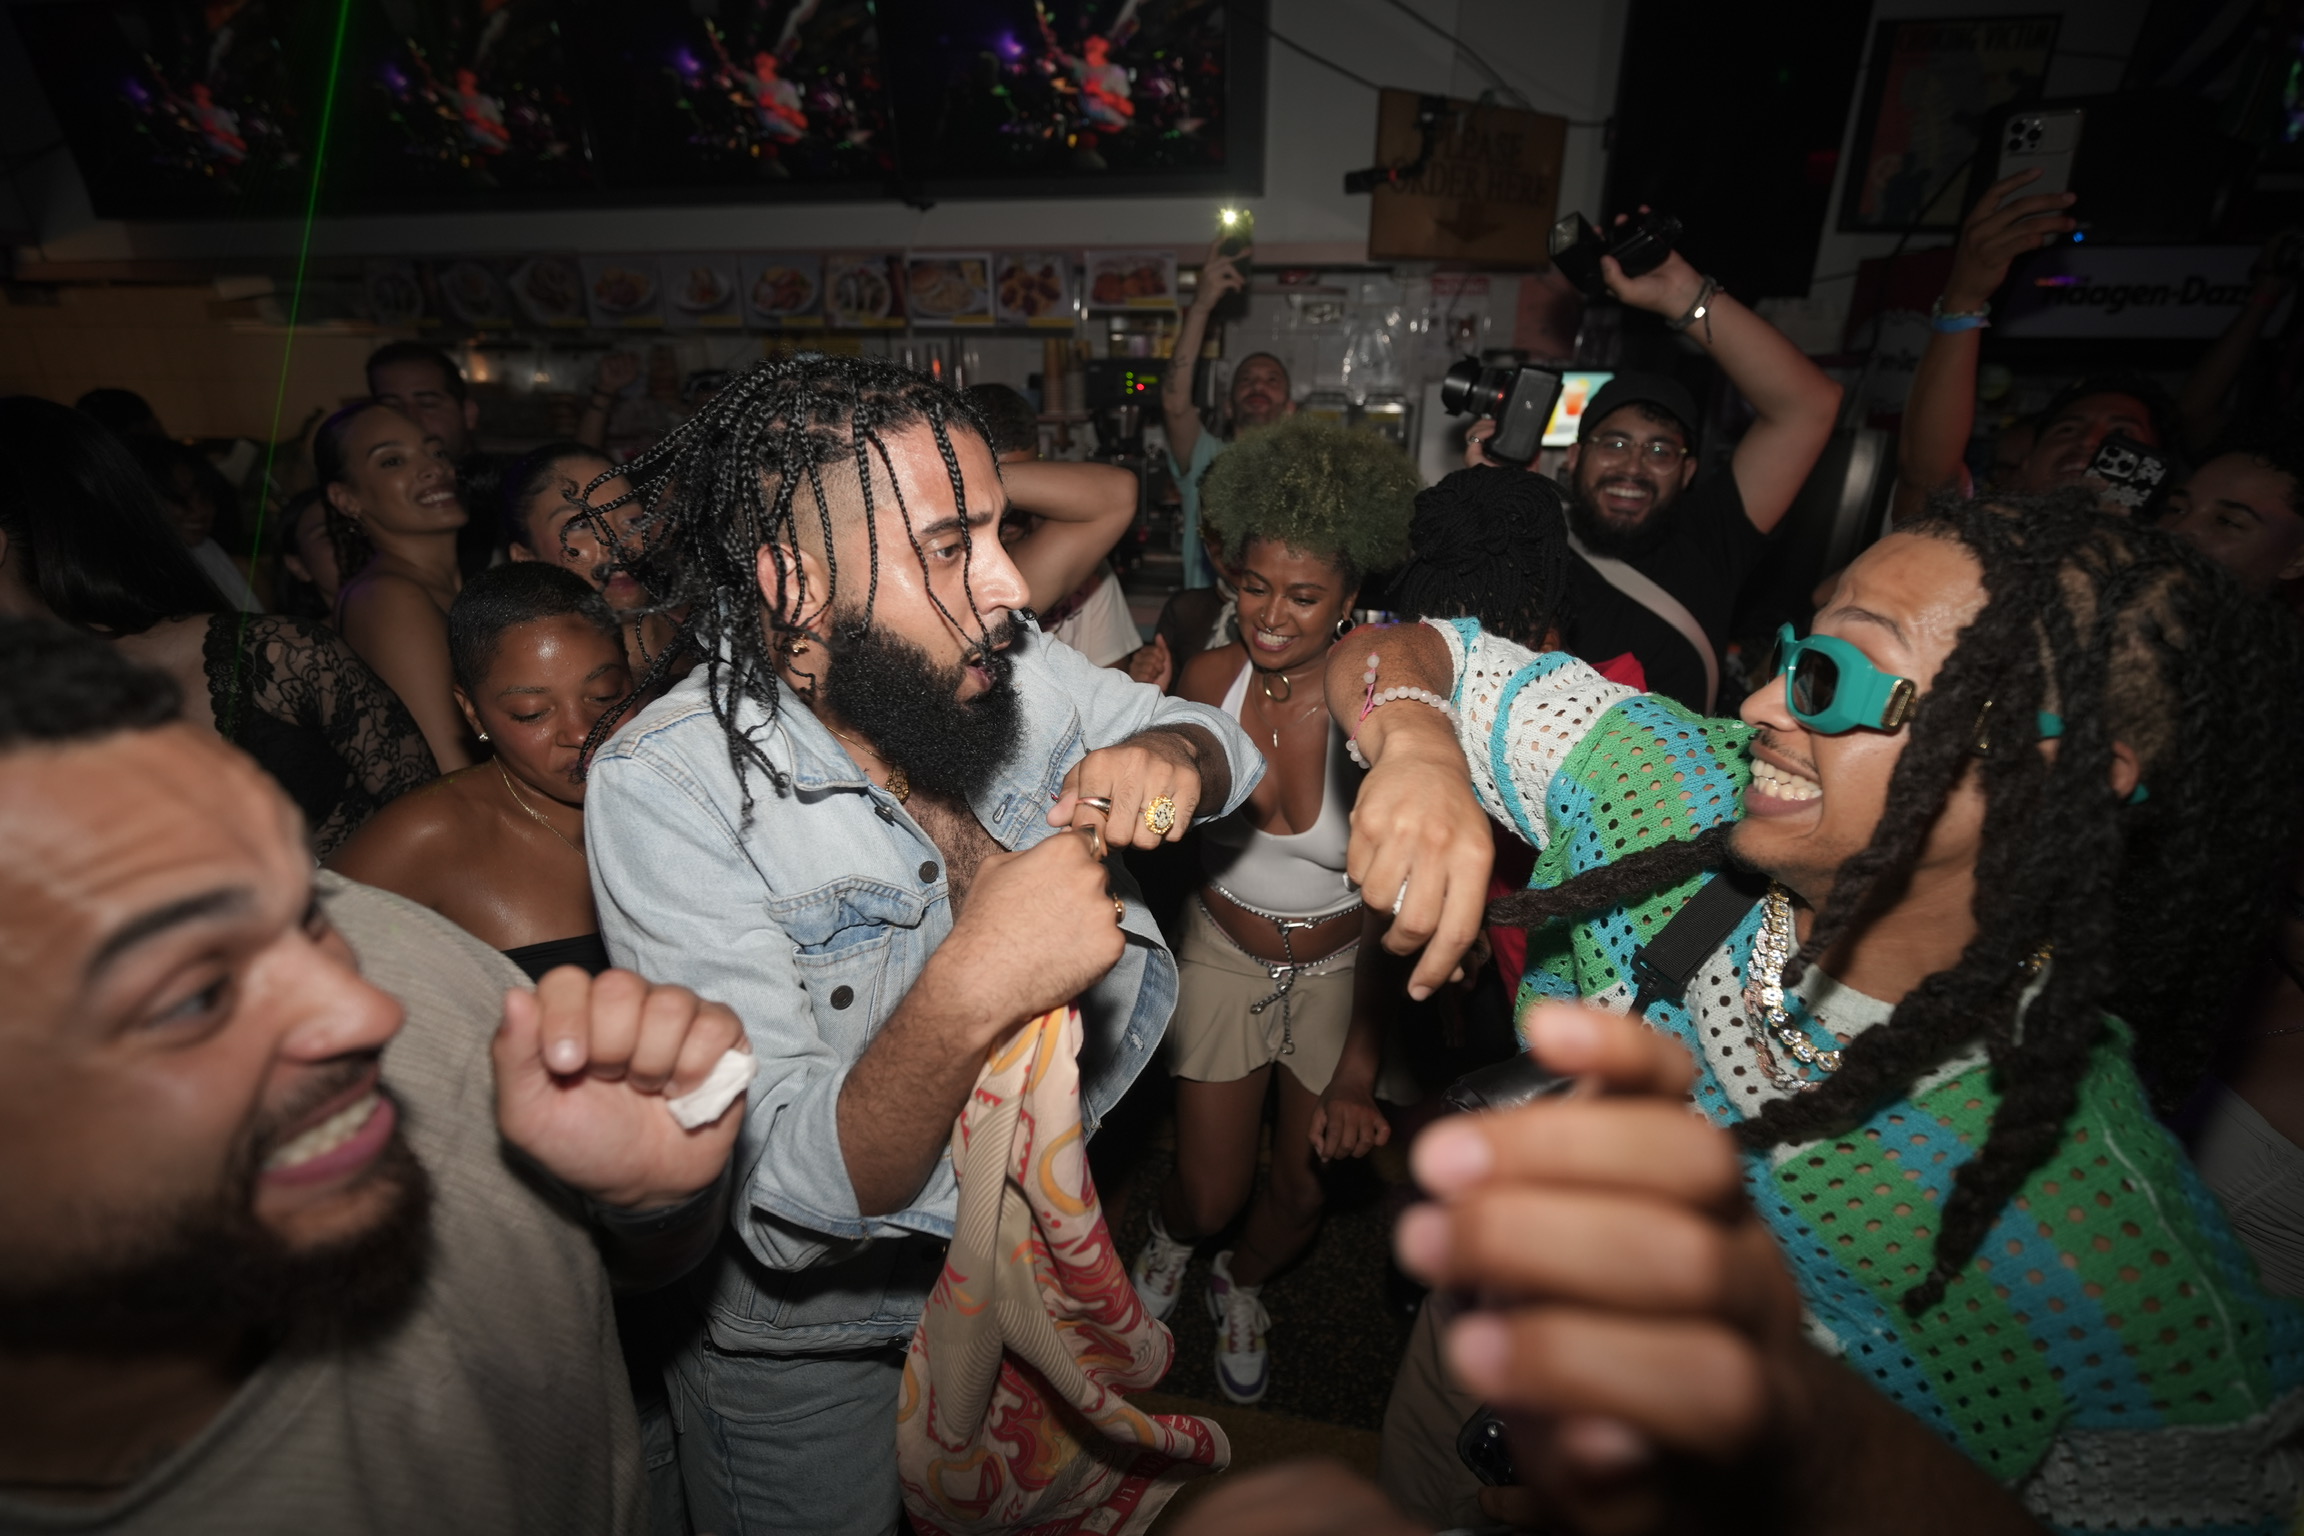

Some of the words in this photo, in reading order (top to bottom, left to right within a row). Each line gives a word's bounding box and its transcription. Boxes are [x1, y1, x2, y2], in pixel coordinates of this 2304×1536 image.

[1434, 122, 1524, 168] PLEASE
[1388, 156, 1478, 198] ORDER
[1486, 169, 1551, 206] HERE
